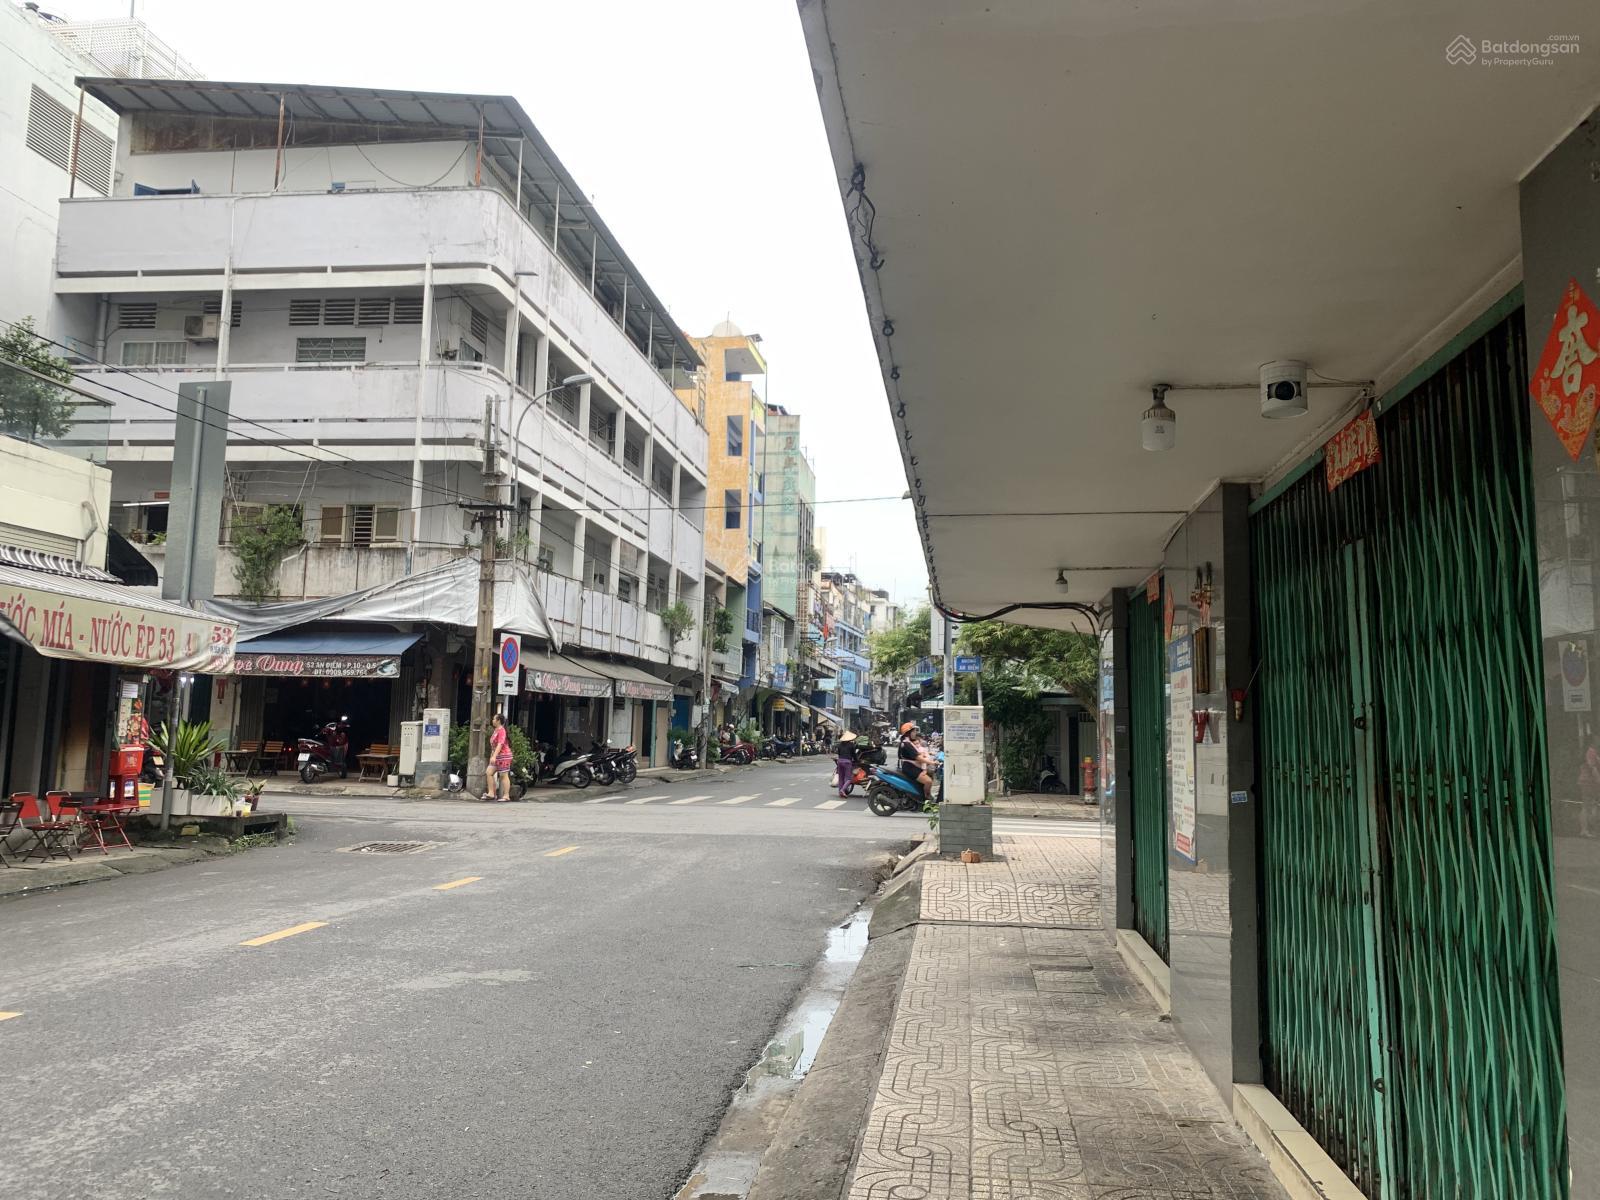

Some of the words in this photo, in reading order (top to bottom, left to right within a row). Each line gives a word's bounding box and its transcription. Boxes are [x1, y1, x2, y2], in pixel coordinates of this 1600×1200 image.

[40, 601, 74, 650] MÍA
[89, 610, 132, 657] NƯỚC
[135, 614, 155, 659] ÉP
[159, 627, 175, 662] 53
[212, 626, 232, 645] 53
